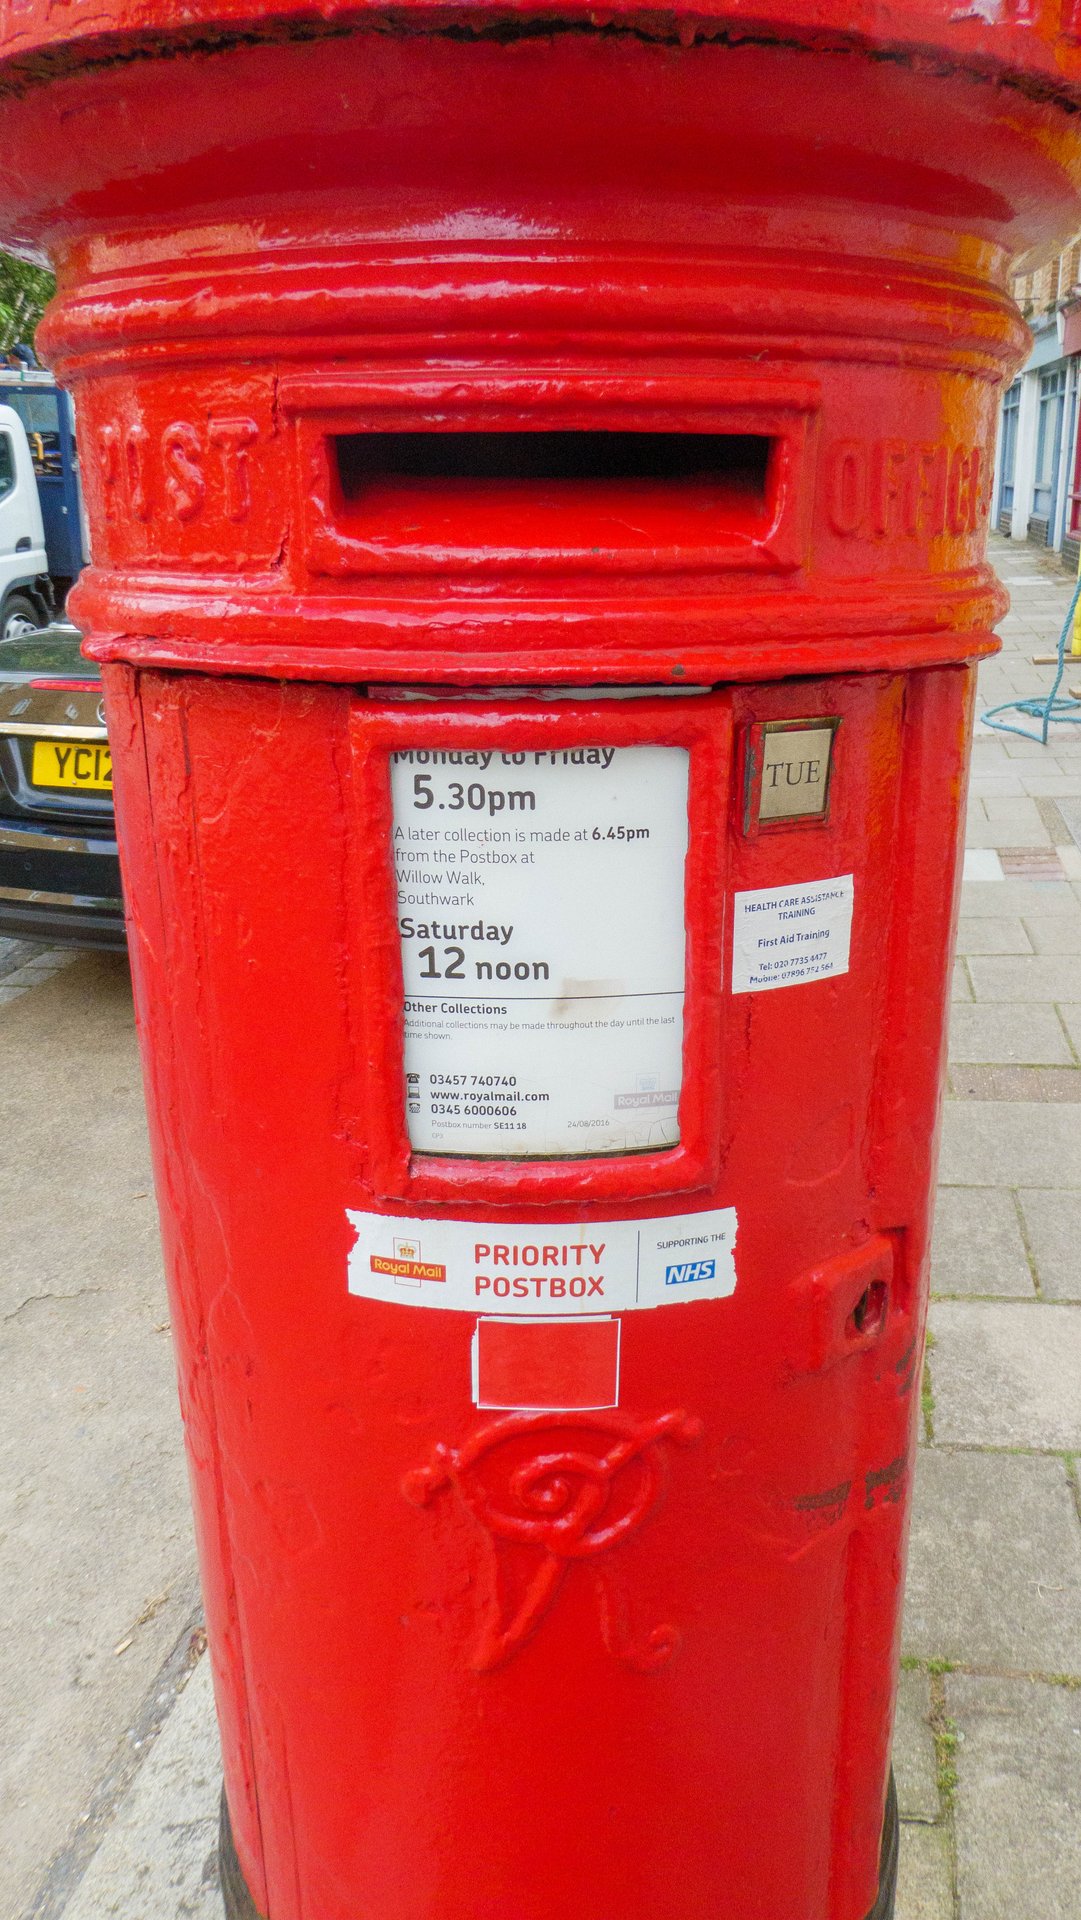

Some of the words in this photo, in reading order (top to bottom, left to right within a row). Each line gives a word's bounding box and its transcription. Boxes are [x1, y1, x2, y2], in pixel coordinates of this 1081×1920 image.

[393, 750, 494, 770] Monday
[501, 751, 526, 765] to
[534, 748, 616, 769] Friday
[766, 760, 821, 788] TUE
[413, 774, 536, 817] 5.30pm
[394, 826, 405, 840] A
[408, 827, 441, 841] later
[444, 828, 511, 842] collection
[515, 828, 526, 842] is
[530, 828, 571, 842] made
[574, 828, 589, 841] at
[591, 826, 650, 842] 6.45pm
[395, 848, 430, 863] from
[433, 849, 456, 863] the
[460, 849, 518, 864] Postbox
[520, 851, 536, 864] at
[395, 869, 443, 884] Willow
[446, 871, 485, 886] Walk,
[397, 890, 475, 906] Southwark
[744, 901, 777, 913] HEALTH
[778, 897, 800, 908] CARE
[777, 907, 816, 921] TRAINING
[400, 917, 514, 946] Saturday
[757, 938, 778, 948] First
[779, 934, 795, 945] Aid
[796, 929, 830, 942] Training
[418, 945, 466, 980] 12
[475, 961, 550, 980] noon
[758, 963, 773, 971] Tel:
[790, 956, 809, 966] 7735
[403, 1001, 438, 1013] Other
[440, 1003, 508, 1015] Collections
[404, 1018, 444, 1029] Additional
[445, 1020, 489, 1030] collections
[490, 1023, 508, 1032] may
[509, 1022, 520, 1030] be
[522, 1021, 546, 1030] made
[546, 1020, 594, 1031] throughout
[594, 1019, 609, 1028] the
[610, 1018, 625, 1029] day
[626, 1017, 645, 1027] until
[646, 1016, 660, 1026] the
[660, 1016, 676, 1025] last
[404, 1031, 423, 1039] time
[429, 1074, 467, 1086] 03457
[470, 1075, 517, 1087] 740740
[430, 1090, 550, 1103] www.royalmail.com
[617, 1093, 651, 1108] Royal
[652, 1091, 678, 1104] Mail
[430, 1103, 461, 1115] 0345
[464, 1105, 517, 1116] 6000606
[431, 1119, 462, 1129] Postbox
[462, 1121, 492, 1130] number
[493, 1122, 515, 1130] SE11
[516, 1122, 527, 1130] 18
[567, 1119, 610, 1128] 24/08/2016
[656, 1235, 709, 1250] SUPPORTING
[710, 1232, 726, 1242] THE
[474, 1243, 606, 1267] PRIORITY
[373, 1257, 411, 1276] Royal
[413, 1264, 443, 1278] Mail
[666, 1260, 714, 1284] NHS
[474, 1275, 605, 1298] POSTBOX
